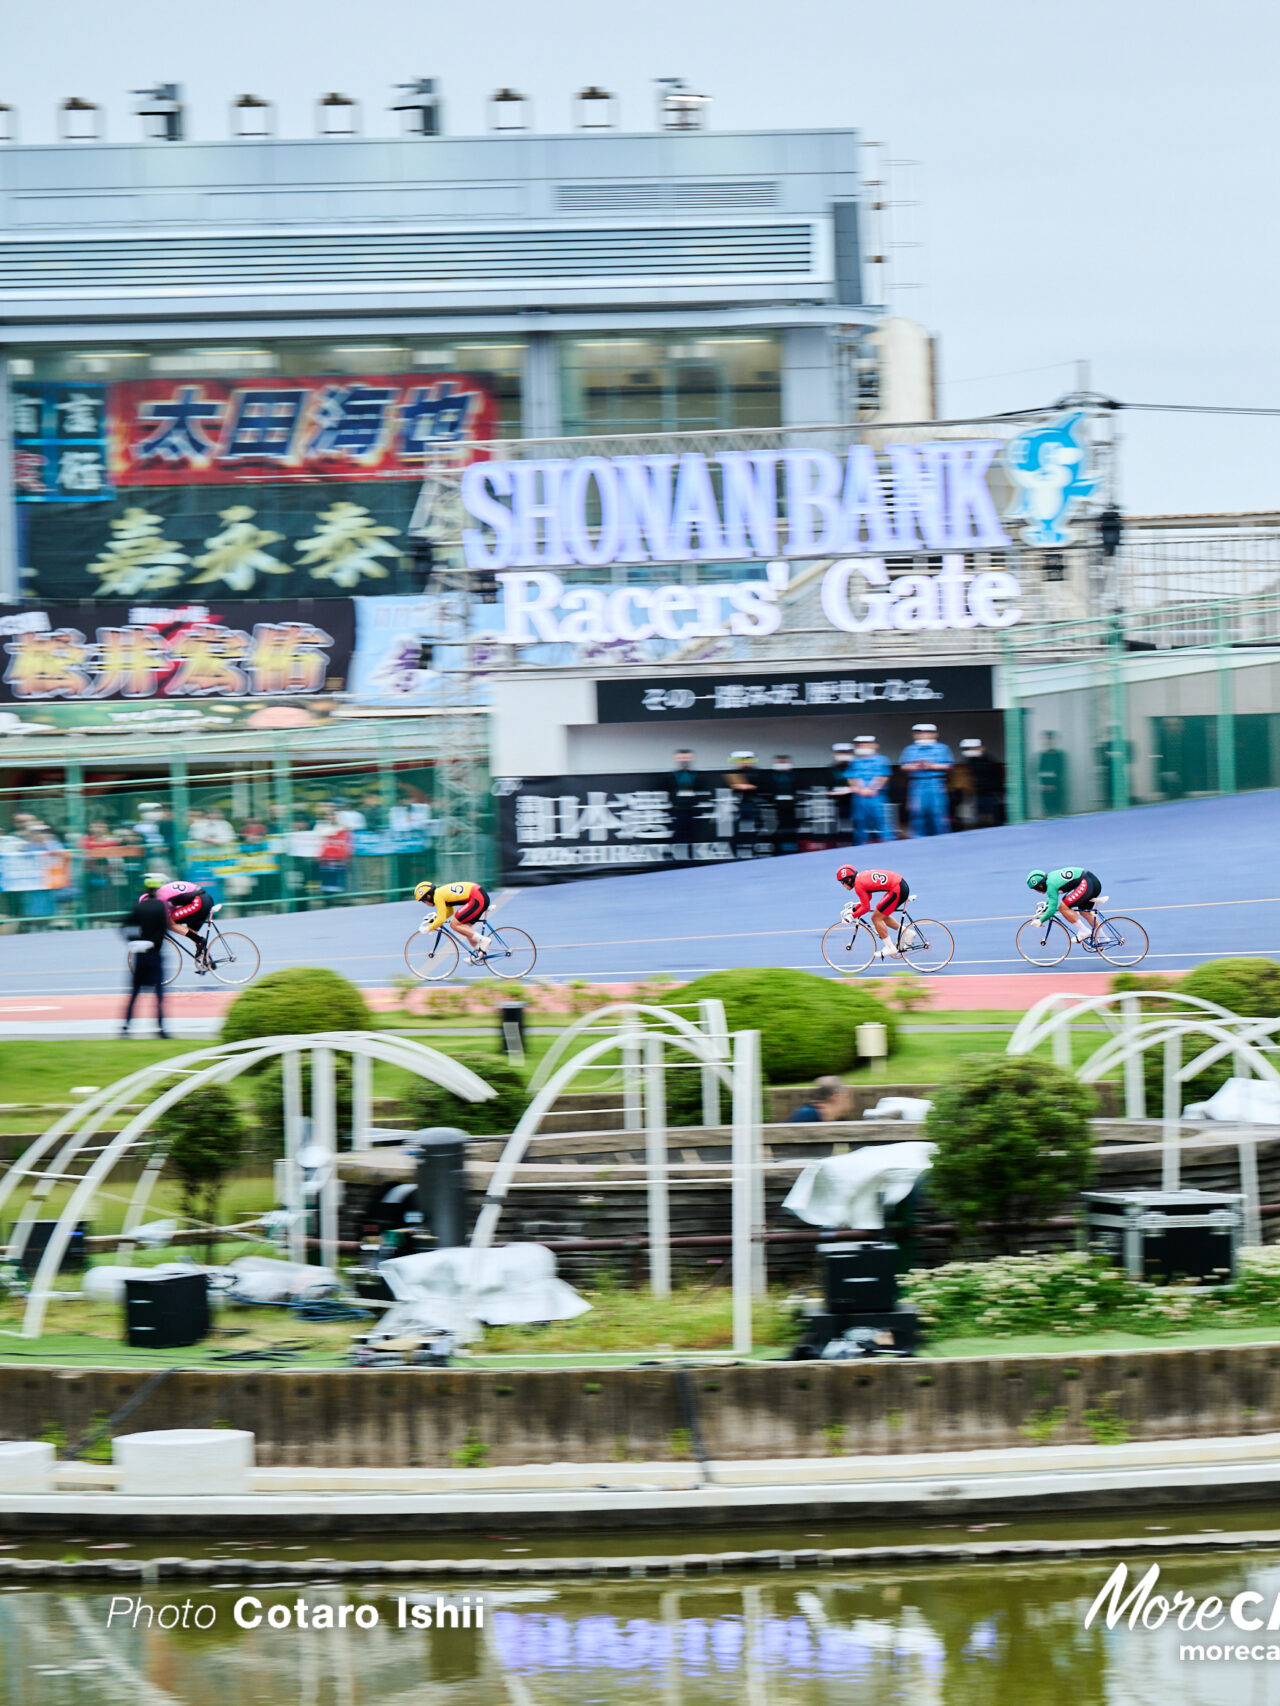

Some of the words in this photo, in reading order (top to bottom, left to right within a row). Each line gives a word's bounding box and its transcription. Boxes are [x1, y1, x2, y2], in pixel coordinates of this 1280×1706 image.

[496, 562, 790, 643] Racers'
[820, 553, 1022, 632] Gate
[871, 871, 888, 886] 3
[1060, 869, 1075, 882] 6
[171, 882, 188, 894] 8
[449, 884, 465, 896] 5
